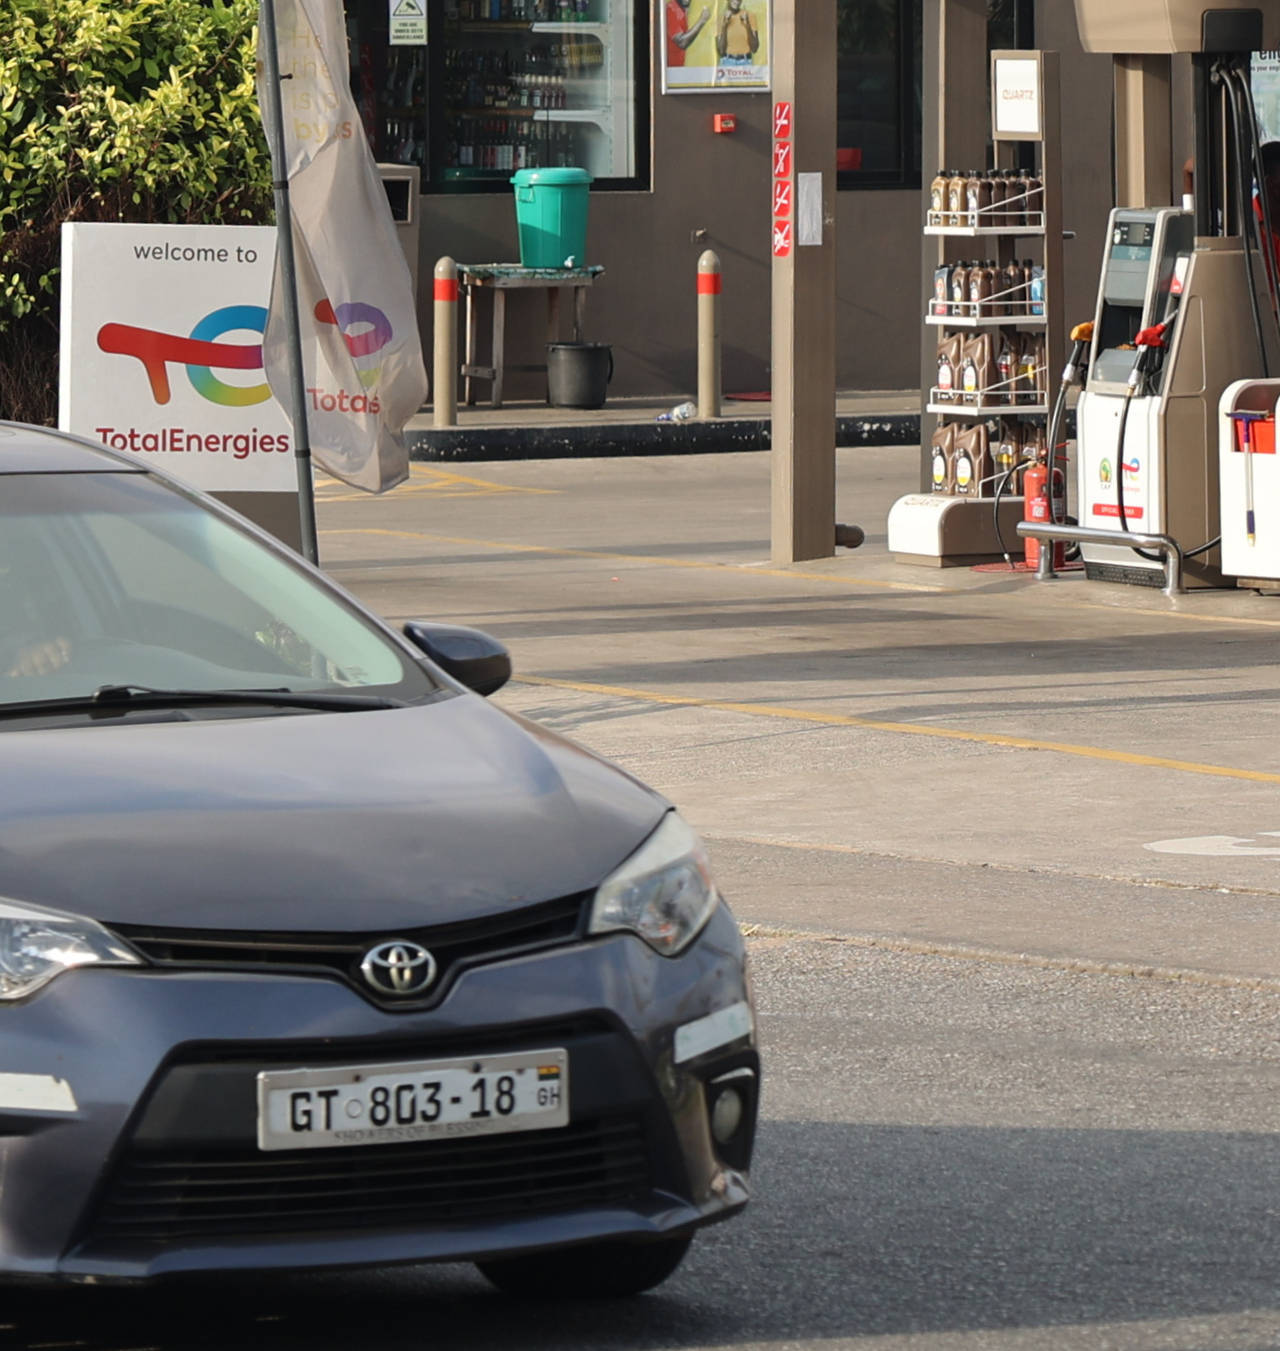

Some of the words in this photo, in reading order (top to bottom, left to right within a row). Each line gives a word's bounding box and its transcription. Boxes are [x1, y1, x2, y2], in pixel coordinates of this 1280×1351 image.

[134, 242, 228, 262] welcome
[236, 244, 258, 263] to
[96, 428, 289, 460] TotalEnergies
[290, 1090, 340, 1132] GT
[369, 1075, 515, 1127] 803-18
[537, 1084, 561, 1107] GH
